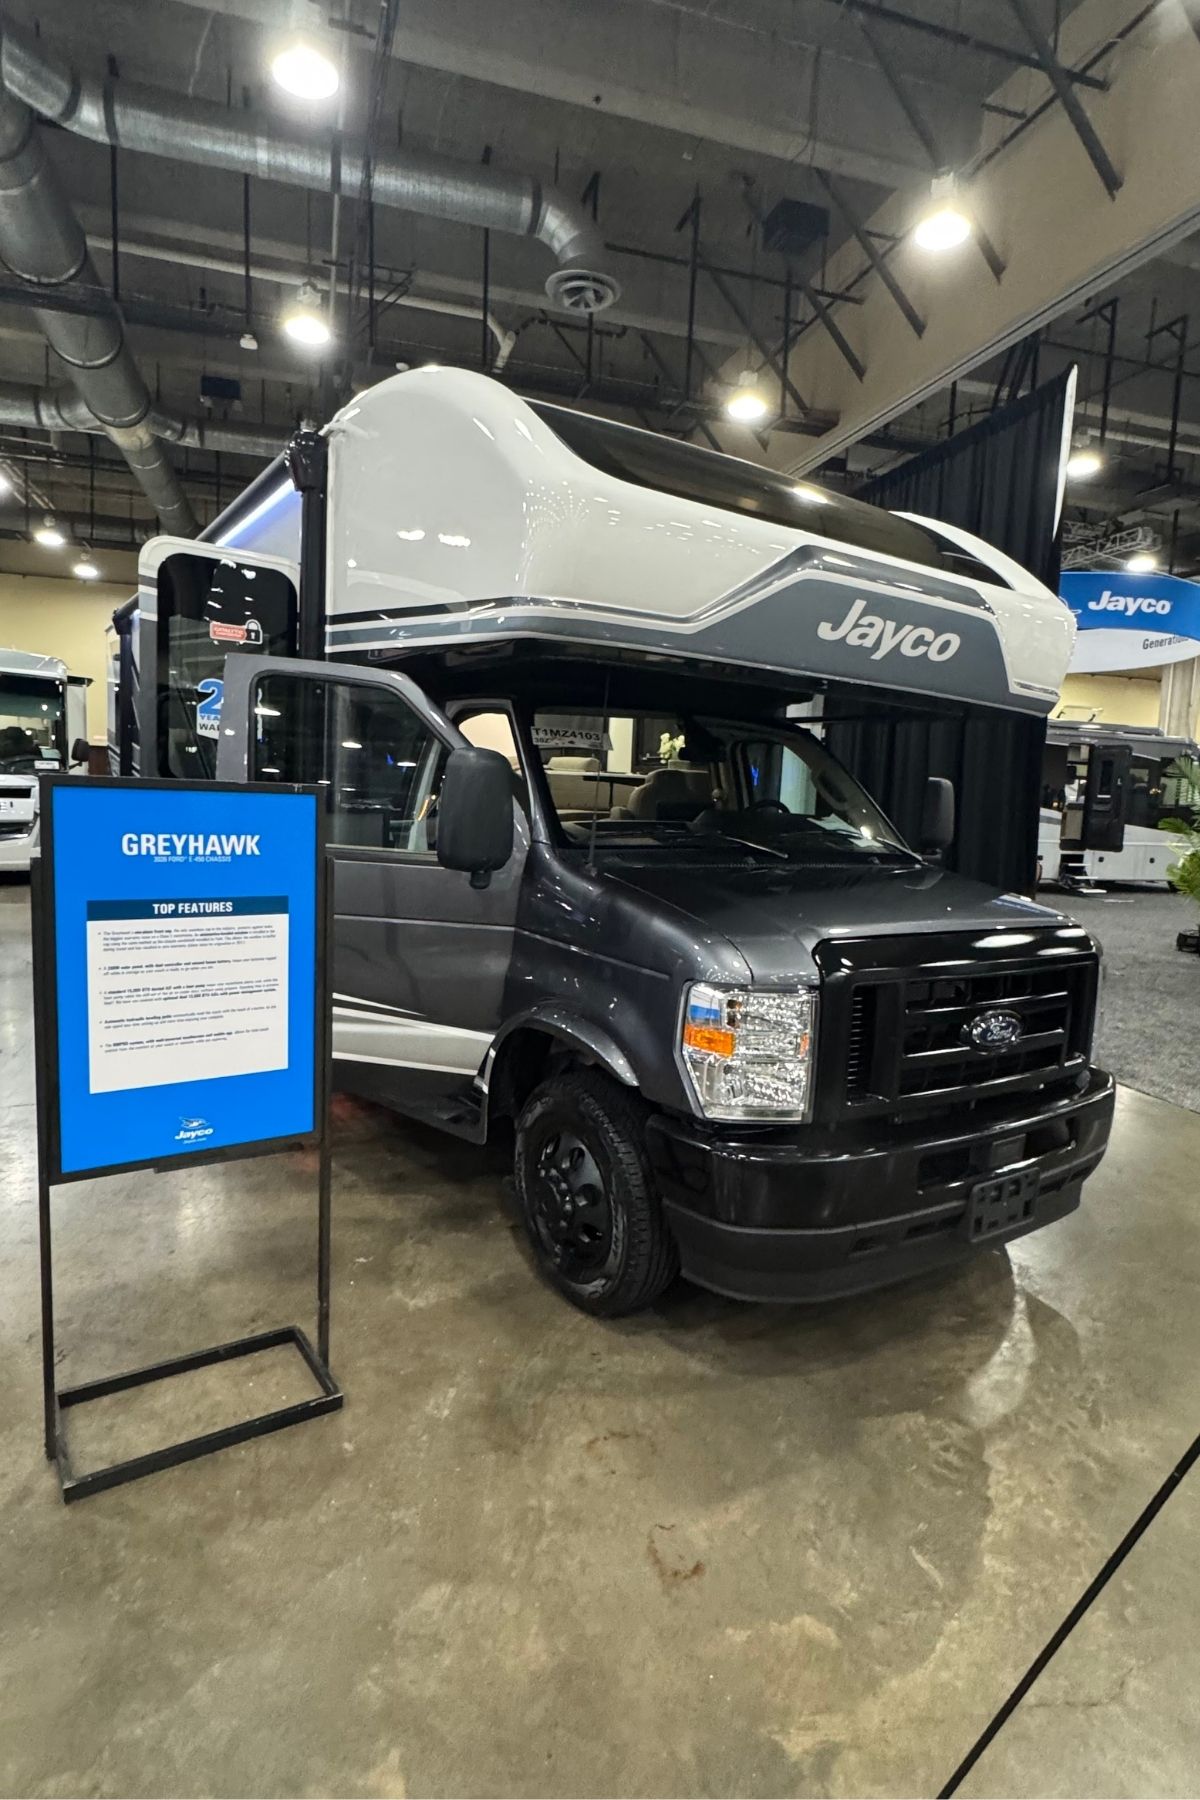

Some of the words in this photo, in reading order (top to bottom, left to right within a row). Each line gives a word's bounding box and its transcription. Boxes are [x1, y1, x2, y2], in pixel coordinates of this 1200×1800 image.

[1088, 591, 1171, 616] Jayco
[817, 599, 961, 662] Jayco
[121, 833, 261, 856] GREYHAWK
[152, 903, 176, 915] TOP
[178, 901, 233, 914] FEATURES
[174, 1128, 214, 1140] Jayco
